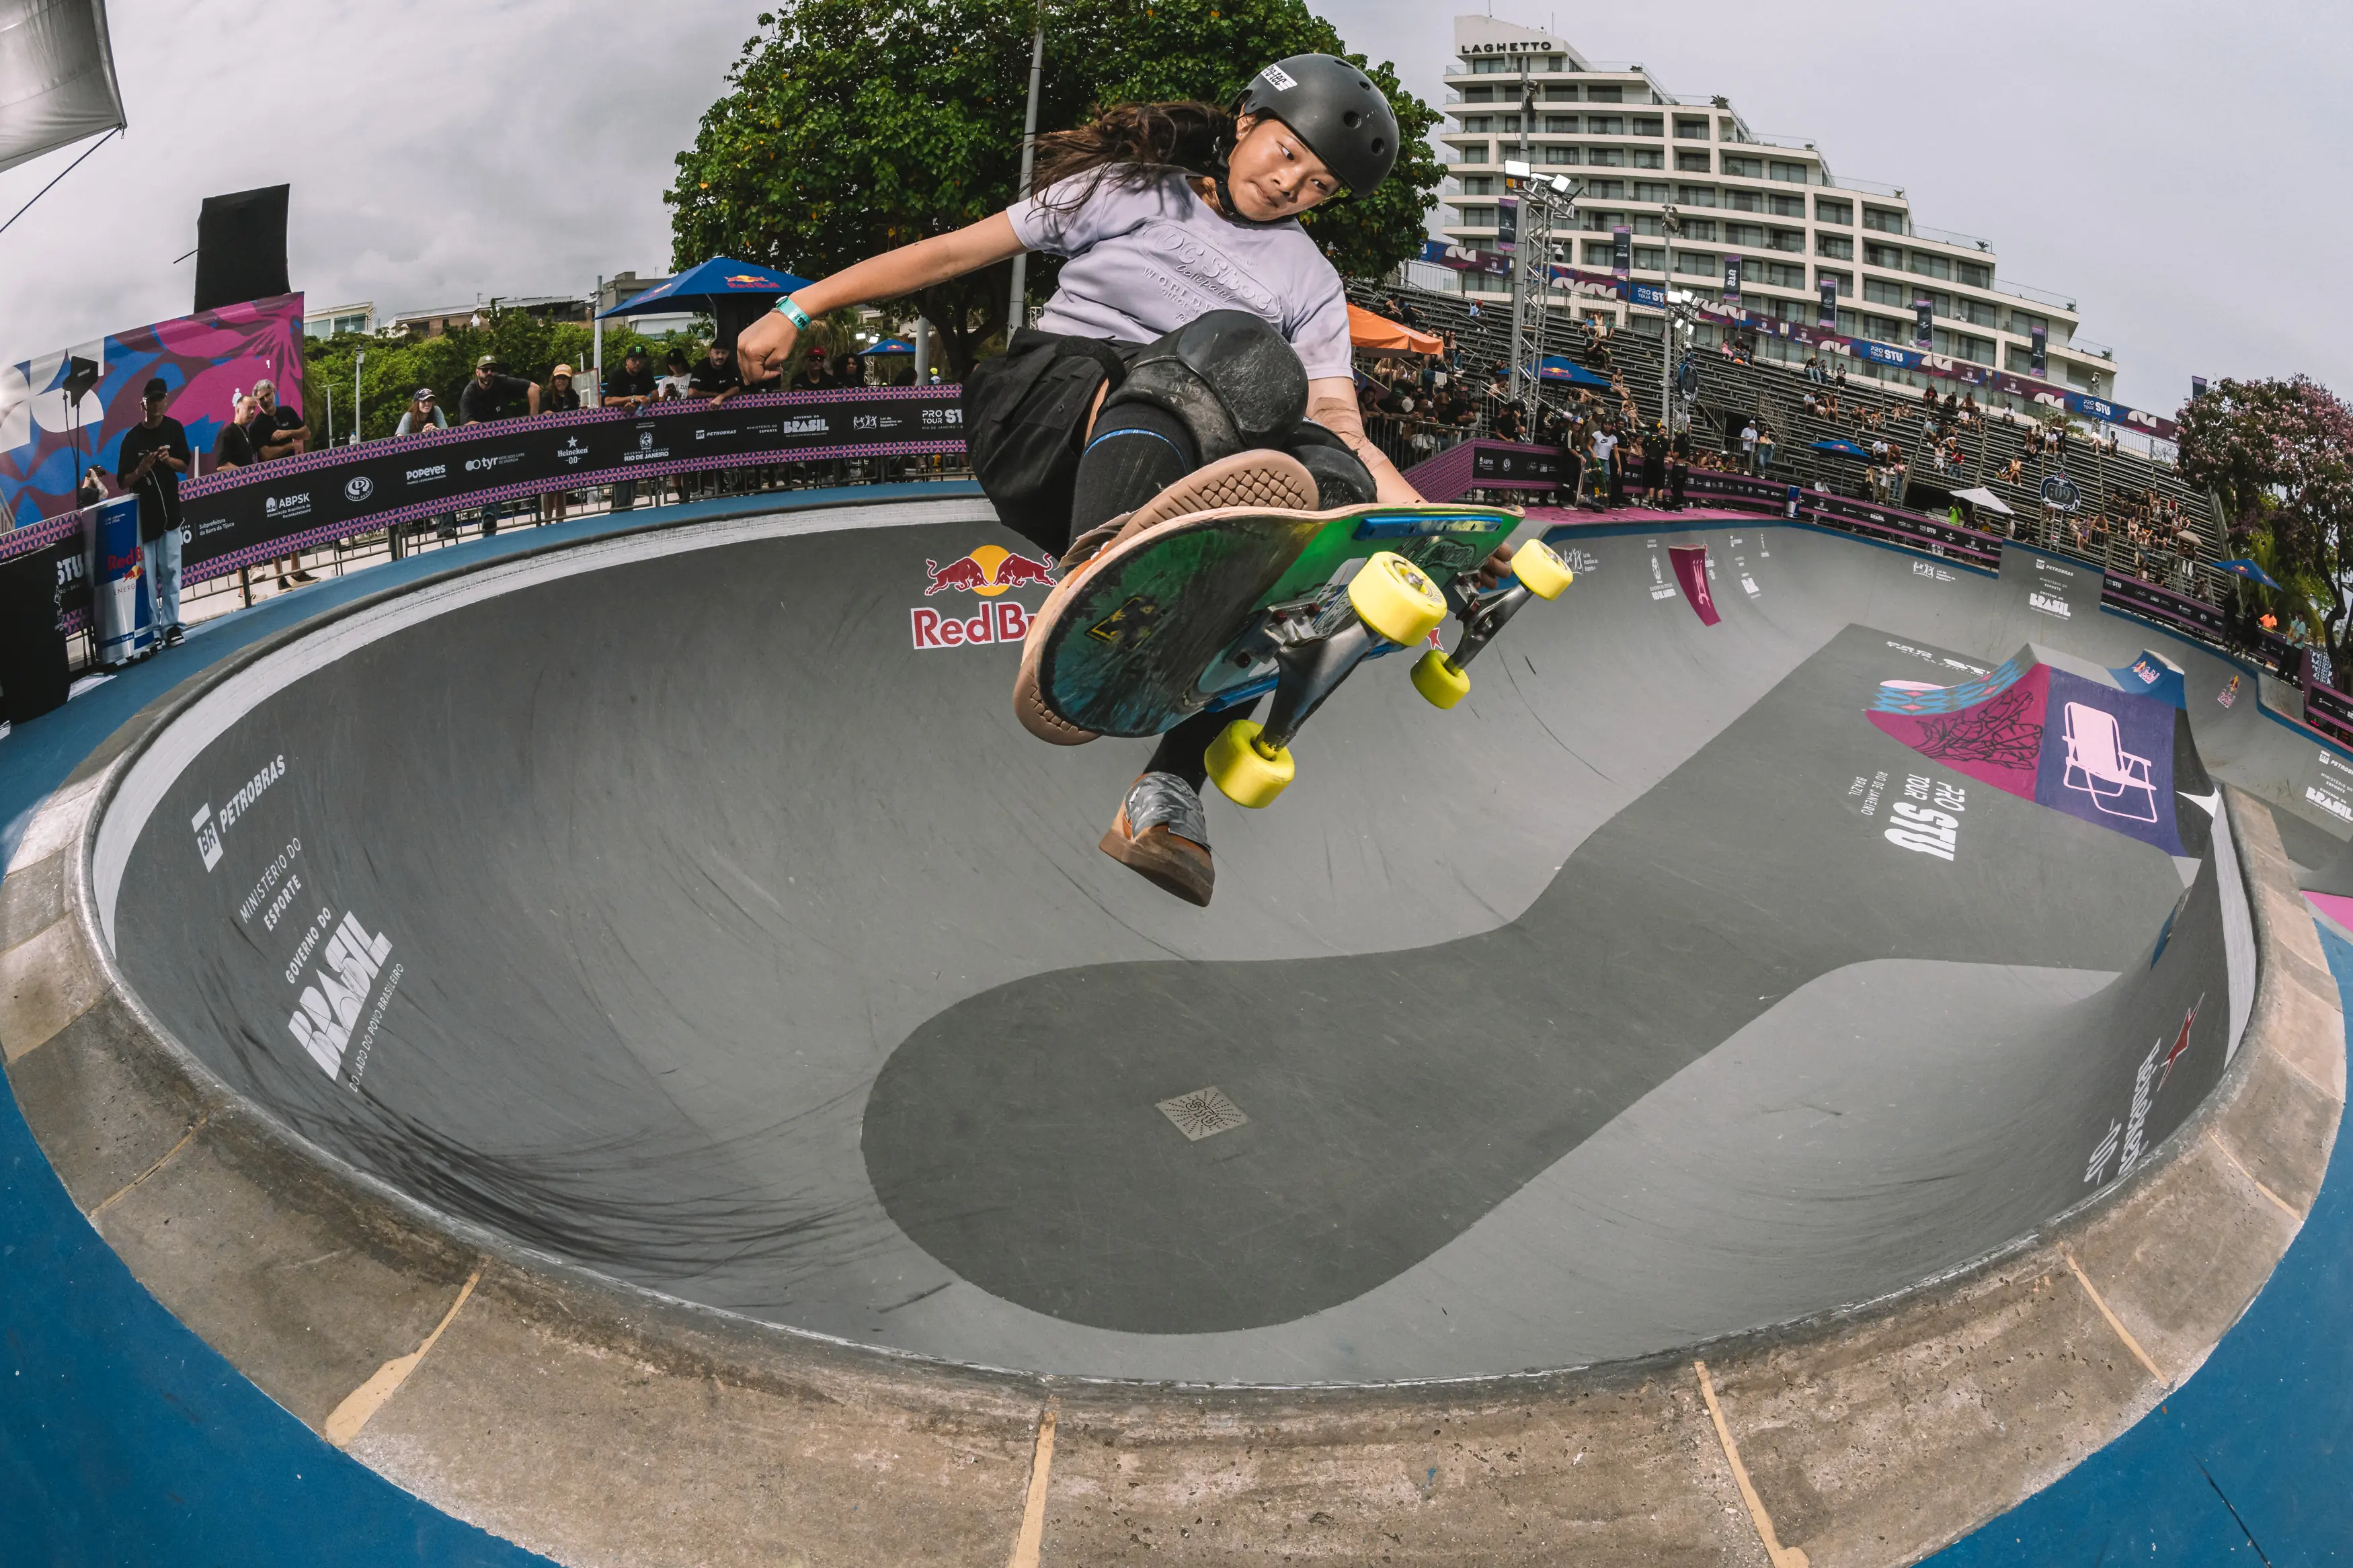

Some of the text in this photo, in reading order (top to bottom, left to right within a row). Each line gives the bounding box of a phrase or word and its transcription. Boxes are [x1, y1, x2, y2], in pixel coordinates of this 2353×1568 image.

[1462, 42, 1551, 53] LAGHETTO
[1652, 292, 1664, 302] ST
[1884, 349, 1903, 362] STU
[945, 409, 963, 423] ST
[2096, 402, 2110, 415] STU
[784, 419, 829, 434] BRASIL
[557, 448, 588, 457] Heineken
[644, 451, 669, 459] JANEIRO
[481, 457, 498, 470] tyr
[279, 493, 310, 509] ABPSK
[288, 505, 305, 513] Brasileira
[199, 518, 226, 530] Subprefeitura
[223, 522, 235, 530] Tijuca
[108, 546, 145, 571] Red B
[2046, 565, 2073, 576] PETROBRAS
[2030, 593, 2071, 616] BRASIL
[911, 601, 1037, 650] Red B
[2330, 760, 2353, 775] PETROB
[1849, 776, 1867, 796] BRAZIL
[1861, 771, 1888, 815] RIO DE JANEIRO
[2326, 781, 2346, 793] ESPORTE
[1937, 782, 1965, 811] PRO
[2319, 788, 2339, 800] GOVERNO
[198, 754, 285, 858] BR PETROBRAS
[2305, 786, 2353, 821] BRASIL
[1884, 774, 1959, 861] TOUR STU
[239, 837, 301, 923] MINISTÉRIO DO
[263, 874, 302, 932] ESPORTE
[285, 907, 331, 984] GOVERNO DO
[288, 910, 393, 1081] BRASIL
[349, 963, 403, 1093] DO LADO DO POVO BRASILEIRO
[1185, 1099, 1223, 1126] STU
